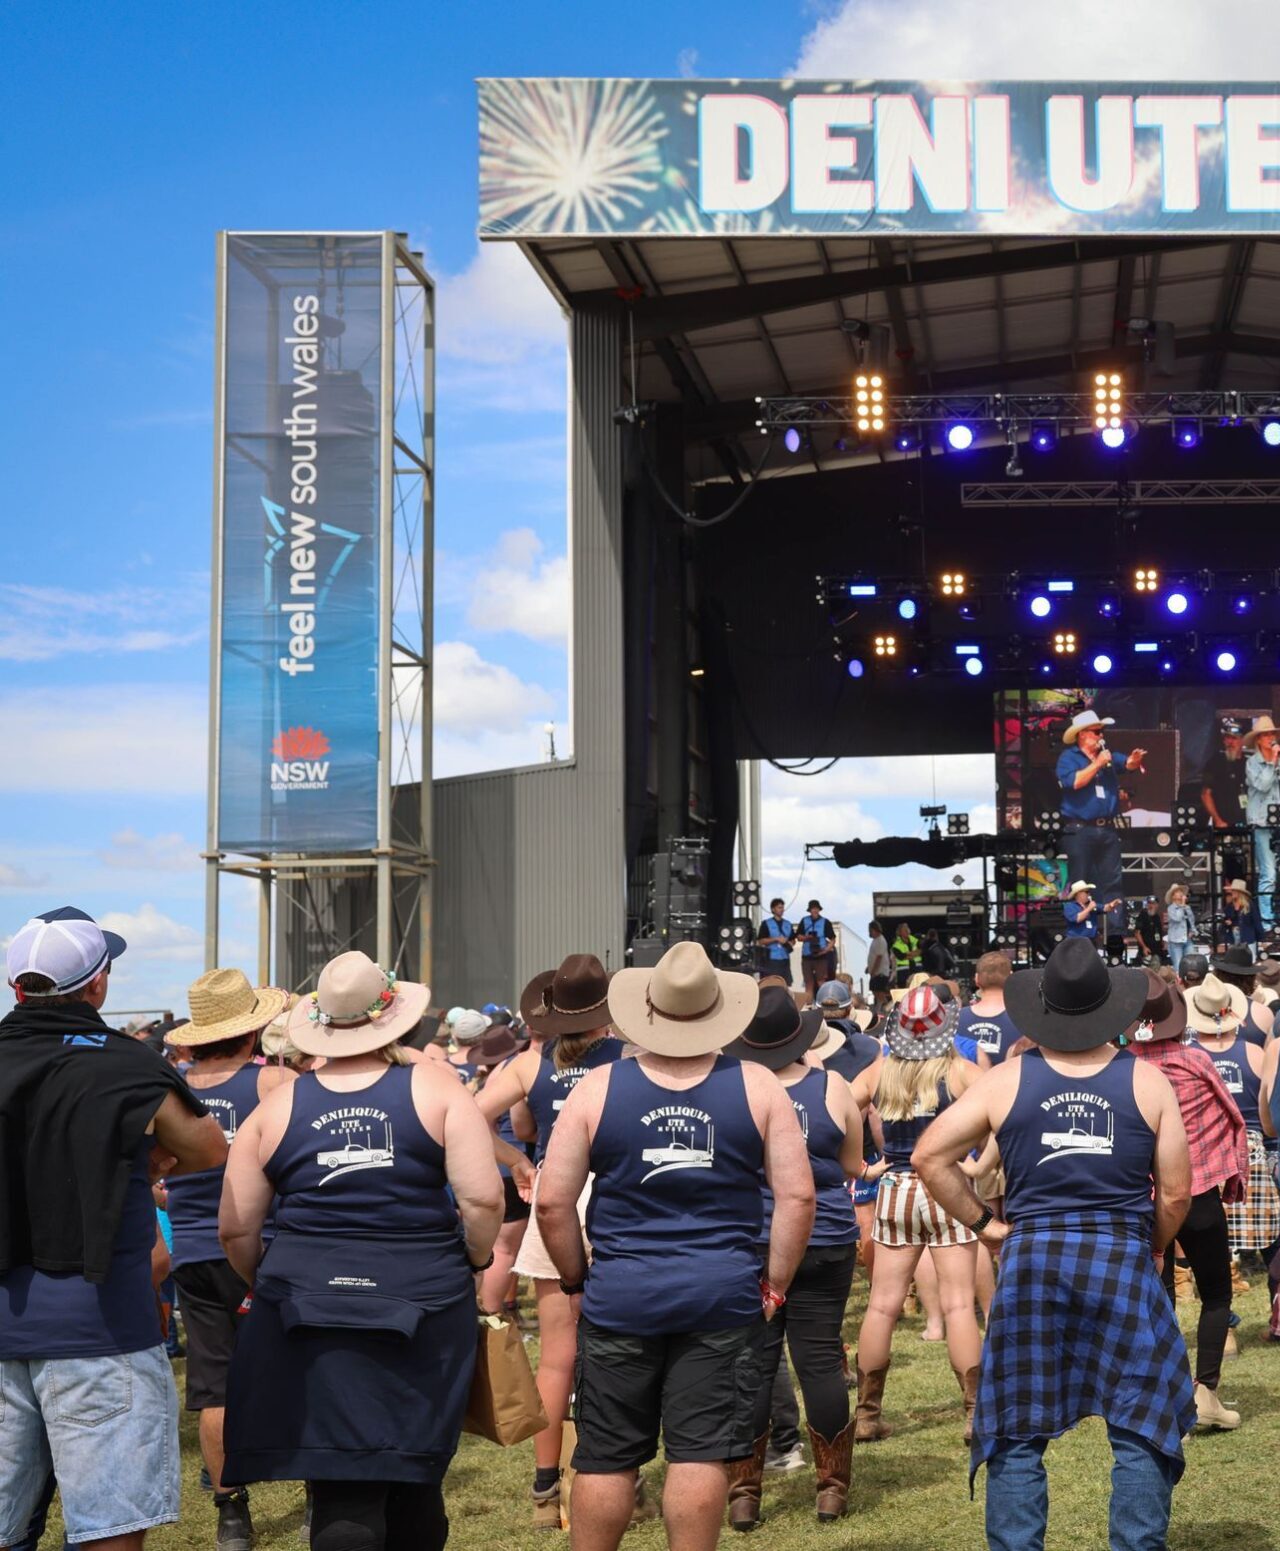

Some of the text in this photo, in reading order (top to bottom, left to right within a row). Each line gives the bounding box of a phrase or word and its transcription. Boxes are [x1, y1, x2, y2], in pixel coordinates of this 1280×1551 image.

[699, 94, 1010, 213] DENI
[280, 294, 319, 676] feel new south wales
[271, 762, 330, 782] NSW
[271, 782, 329, 790] GOVERNMENT
[1040, 1092, 1111, 1112] DENILIQUIN
[311, 1107, 388, 1130] DENILIQUIN
[341, 1120, 360, 1129] UTE
[641, 1106, 711, 1126] DENILIQUIN
